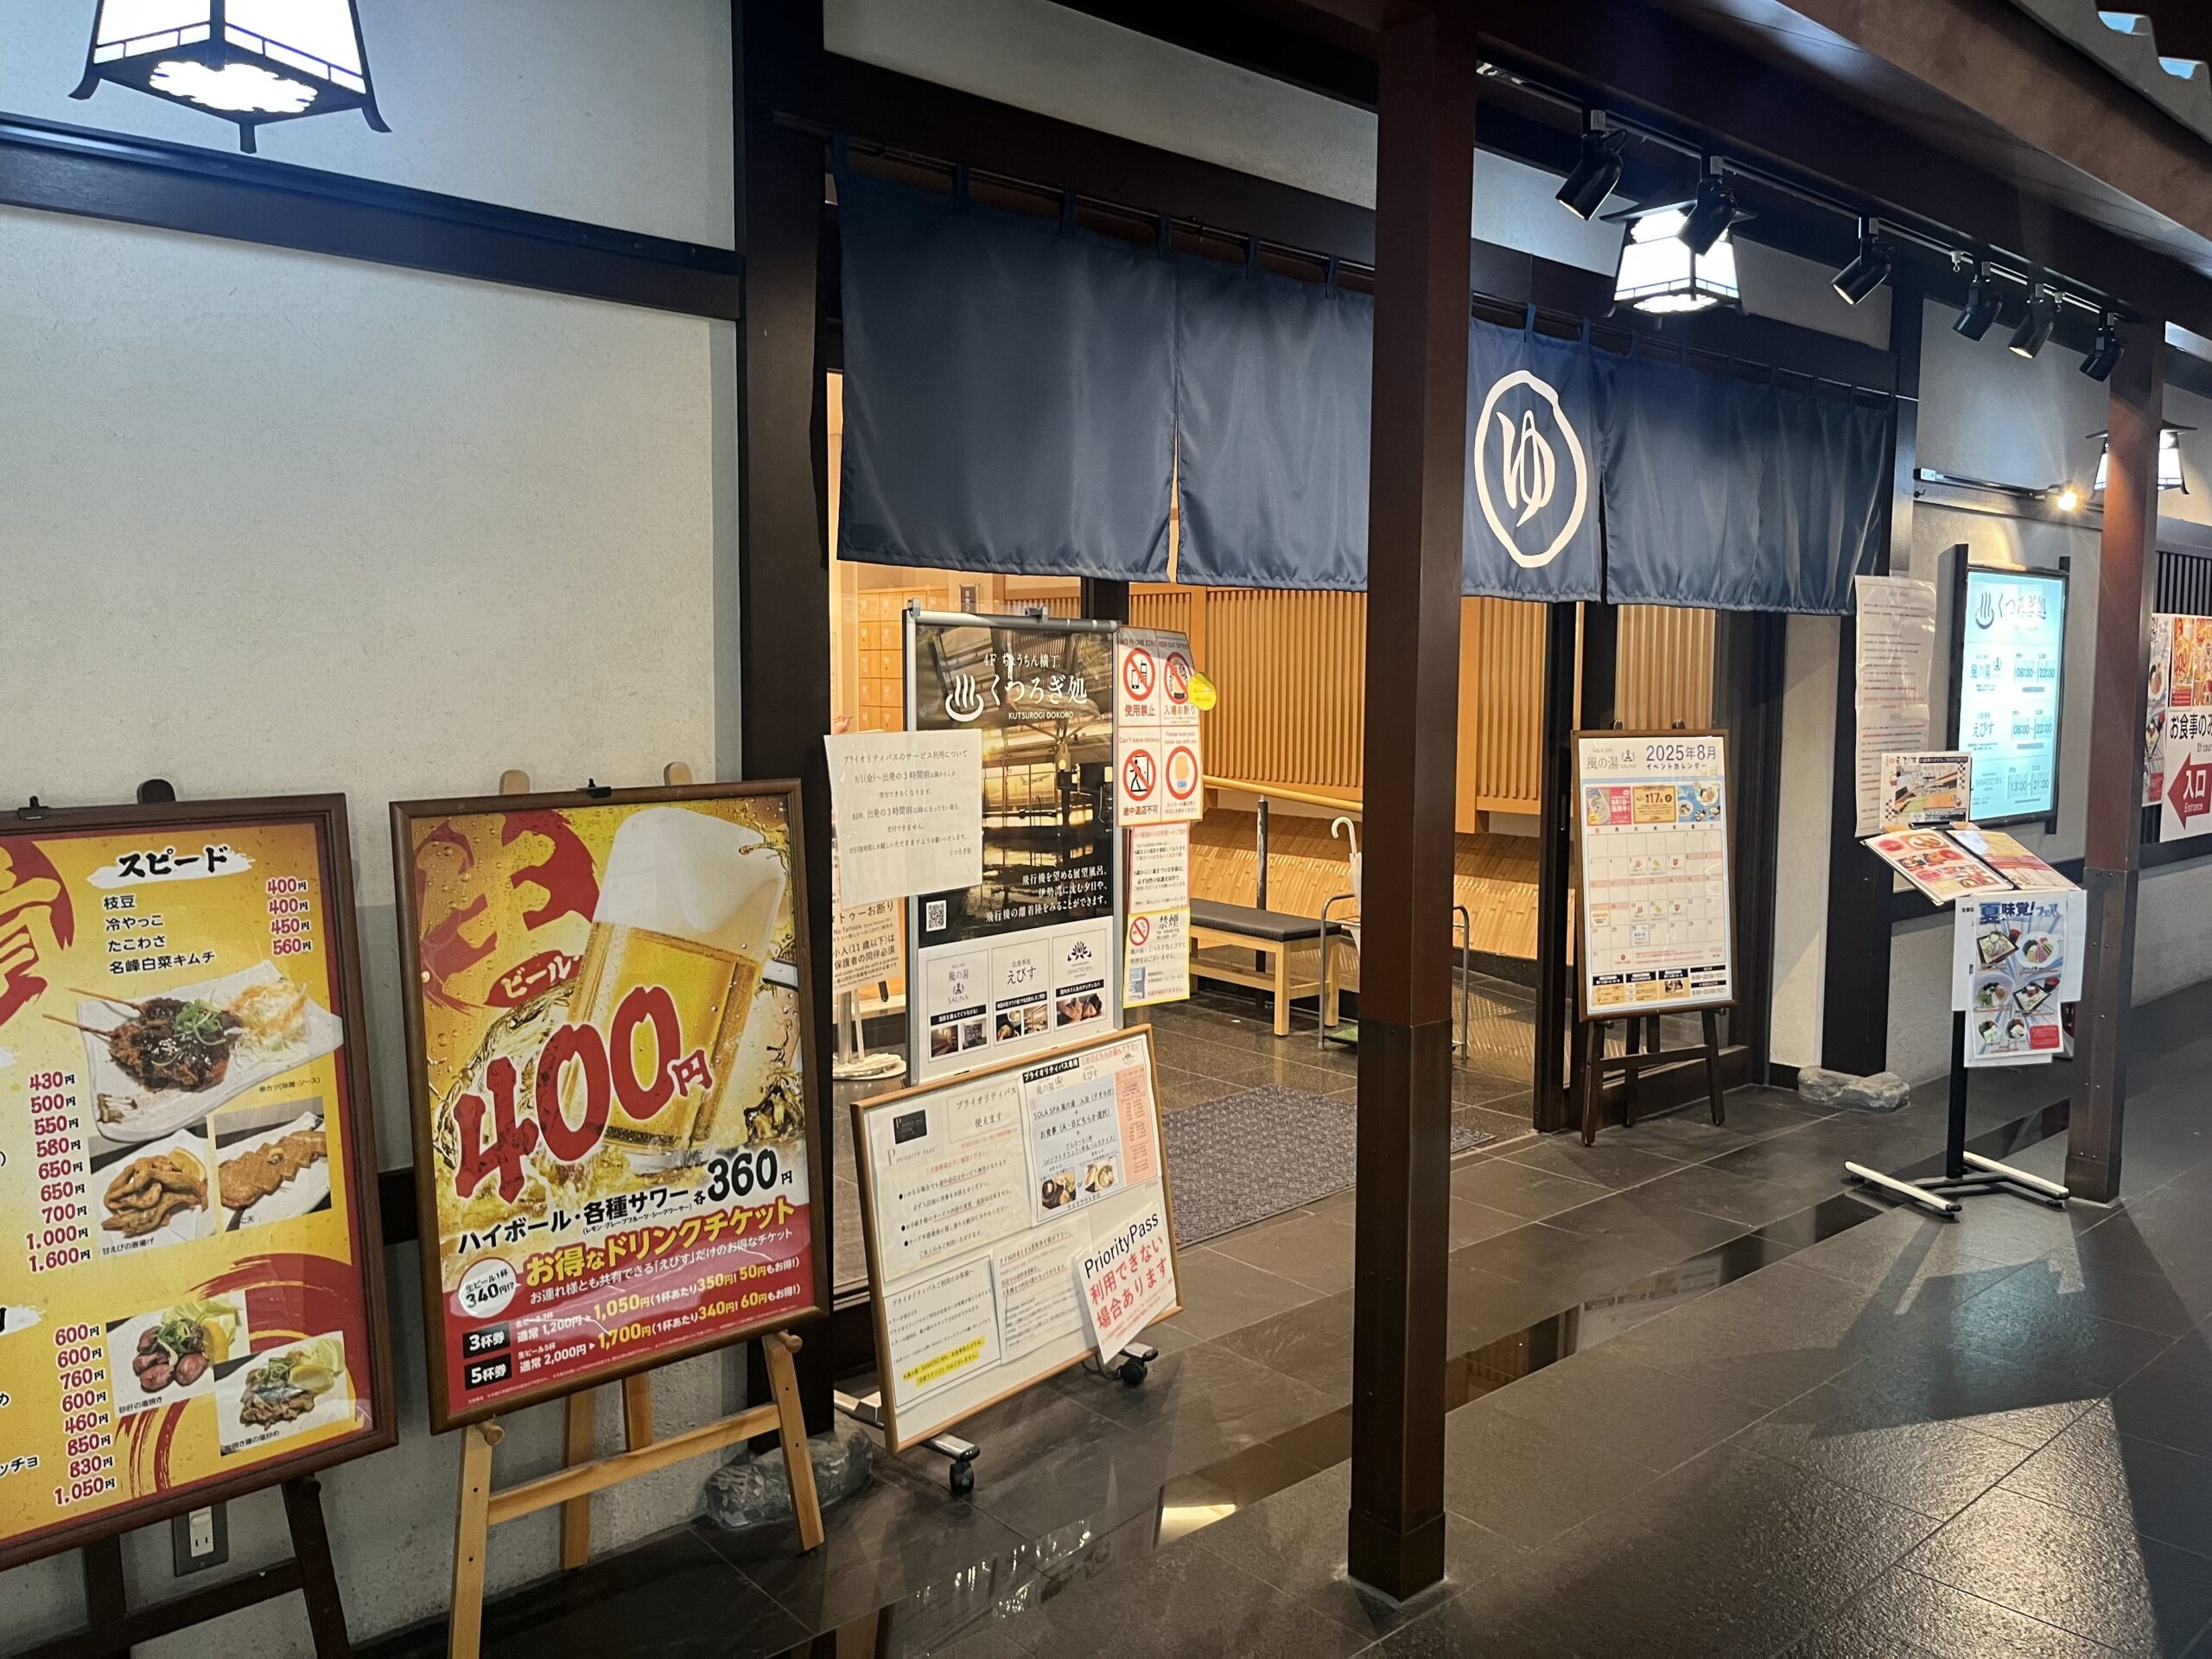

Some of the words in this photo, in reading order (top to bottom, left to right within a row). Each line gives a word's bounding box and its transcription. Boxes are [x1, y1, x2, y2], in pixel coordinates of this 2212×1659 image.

[1496, 409, 1556, 527] ゆ
[983, 653, 997, 666] 4F
[990, 674, 1088, 706] くつろぎ処
[1124, 704, 1155, 717] 使用禁止
[1163, 704, 1196, 716] 入場お断り
[1586, 756, 1618, 770] 風の湯
[1646, 744, 1716, 761] 2025年8月
[2183, 769, 2207, 799] 入口
[2184, 803, 2203, 813] Entrance
[118, 846, 229, 879] スピード
[266, 877, 308, 894] 400円
[103, 894, 137, 911] 枝豆
[268, 897, 309, 914] 400円
[833, 900, 893, 924] トゥーお断り
[105, 913, 165, 932] 冷やっこ
[270, 918, 311, 935] 450円
[106, 935, 167, 953] たこわさ
[272, 938, 312, 956] 560円
[109, 950, 216, 976] 名峰白菜キムチ
[500, 954, 573, 999] ビール
[1007, 966, 1037, 985] えびす
[947, 995, 969, 1005] SAUNA
[29, 1071, 76, 1091] 430円
[30, 1093, 77, 1115] 500円
[454, 985, 714, 1205] 400円
[956, 1086, 1018, 1110] プライオリティパス
[34, 1116, 79, 1136] 550円
[975, 1112, 1002, 1128] 使えます
[38, 1159, 84, 1180] 650円
[40, 1181, 86, 1203] 650円
[41, 1203, 88, 1224] 700円
[458, 1185, 690, 1255] ハイボール・各種サワー
[102, 1237, 155, 1255] 甘えびの唐揚げ
[525, 1198, 796, 1287] お得なドリンクチケット
[1084, 1212, 1159, 1280] PriorityPass
[465, 1268, 510, 1293] 生ビール1杯
[1090, 1236, 1164, 1306] 利用できない
[1096, 1256, 1167, 1329] 場合あります
[54, 1324, 100, 1347] 600円
[517, 1327, 539, 1344] 通常
[542, 1315, 582, 1336] 1,200円
[468, 1331, 505, 1351] 3杯券
[518, 1341, 556, 1359] 生ビール5杯
[57, 1346, 103, 1369] 600円
[519, 1357, 542, 1373] 通常
[543, 1344, 587, 1365] 2,000円
[60, 1368, 105, 1390] 760円
[470, 1363, 507, 1384] 5杯券
[62, 1389, 107, 1413] 600円
[65, 1412, 109, 1434] 460円
[67, 1433, 111, 1457] 850円
